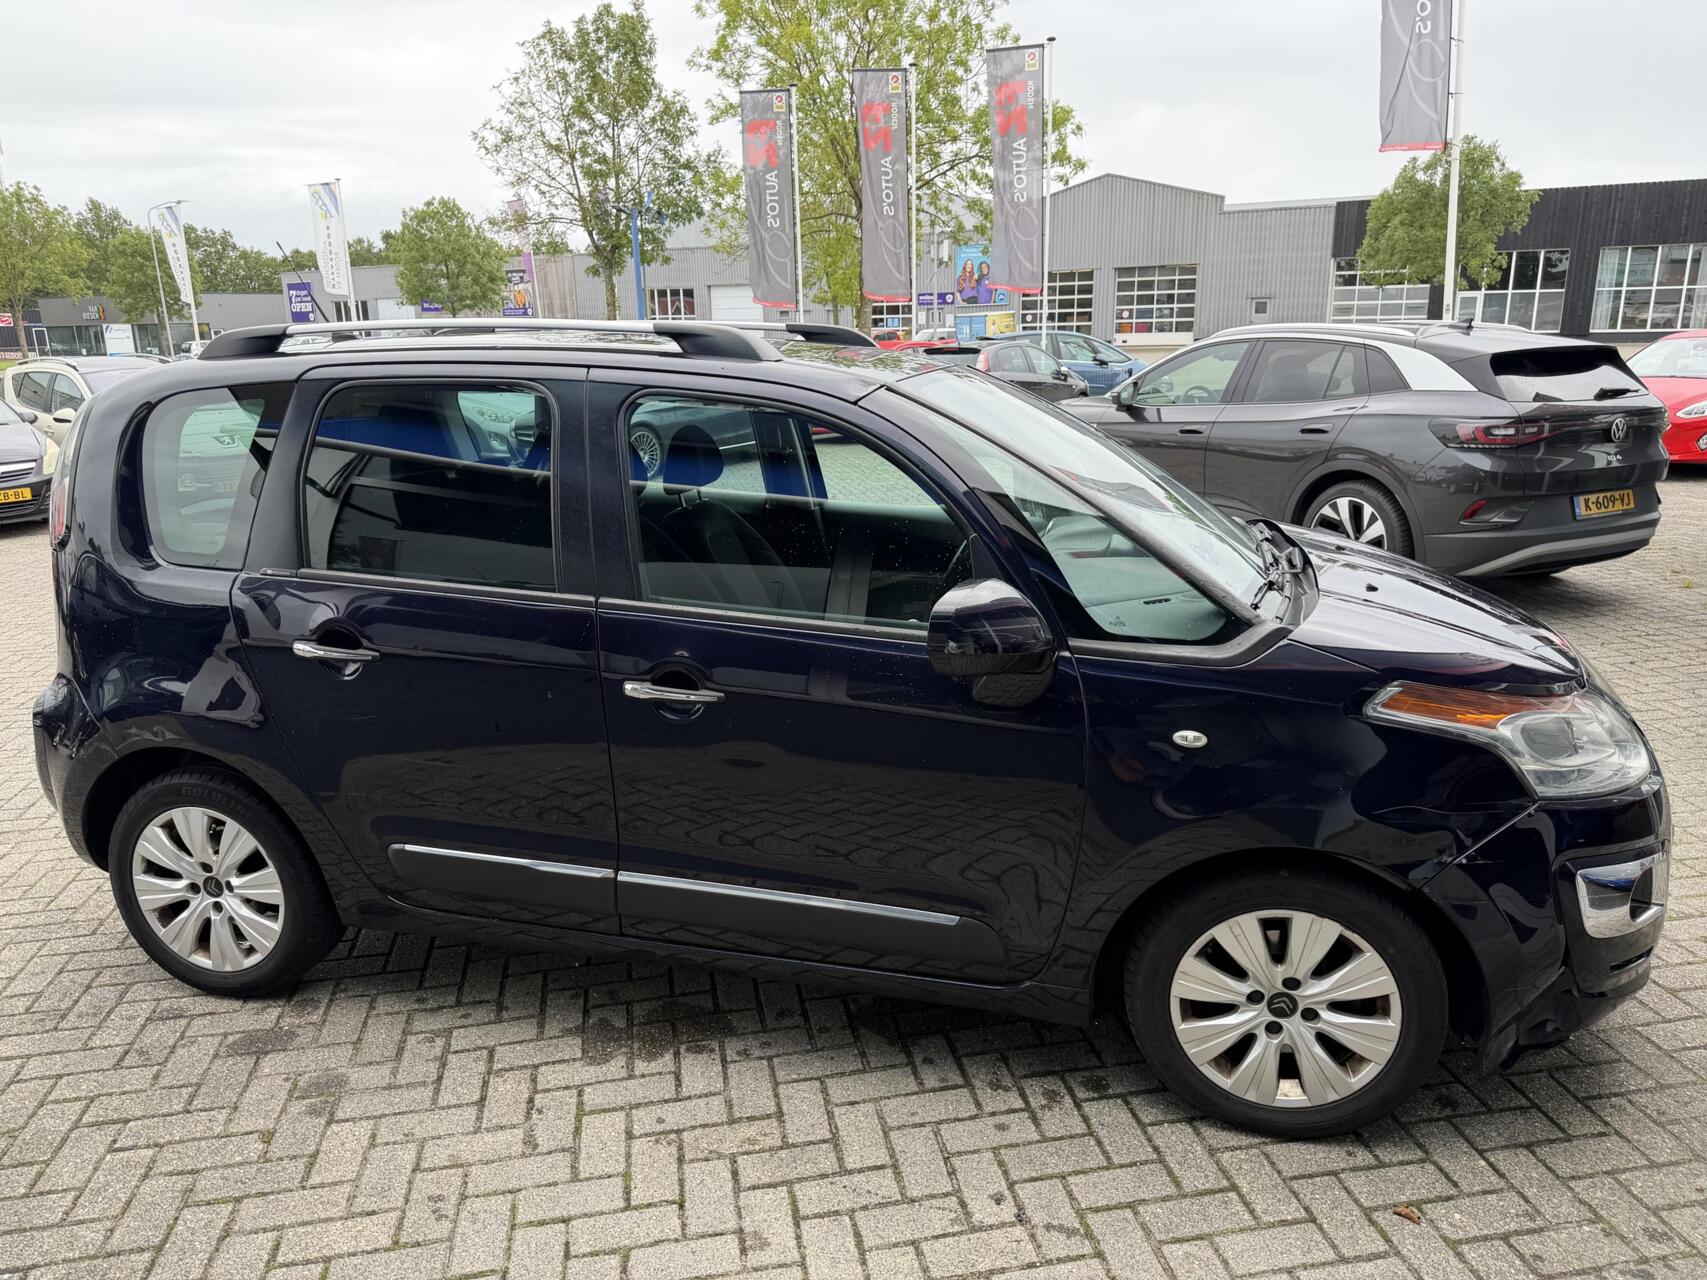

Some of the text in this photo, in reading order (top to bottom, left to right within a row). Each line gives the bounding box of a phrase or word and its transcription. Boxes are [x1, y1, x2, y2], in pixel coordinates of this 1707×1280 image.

[290, 290, 296, 303] 7
[88, 304, 98, 313] VAN
[291, 302, 312, 312] OPEN
[1584, 492, 1631, 512] K-609-VJ
